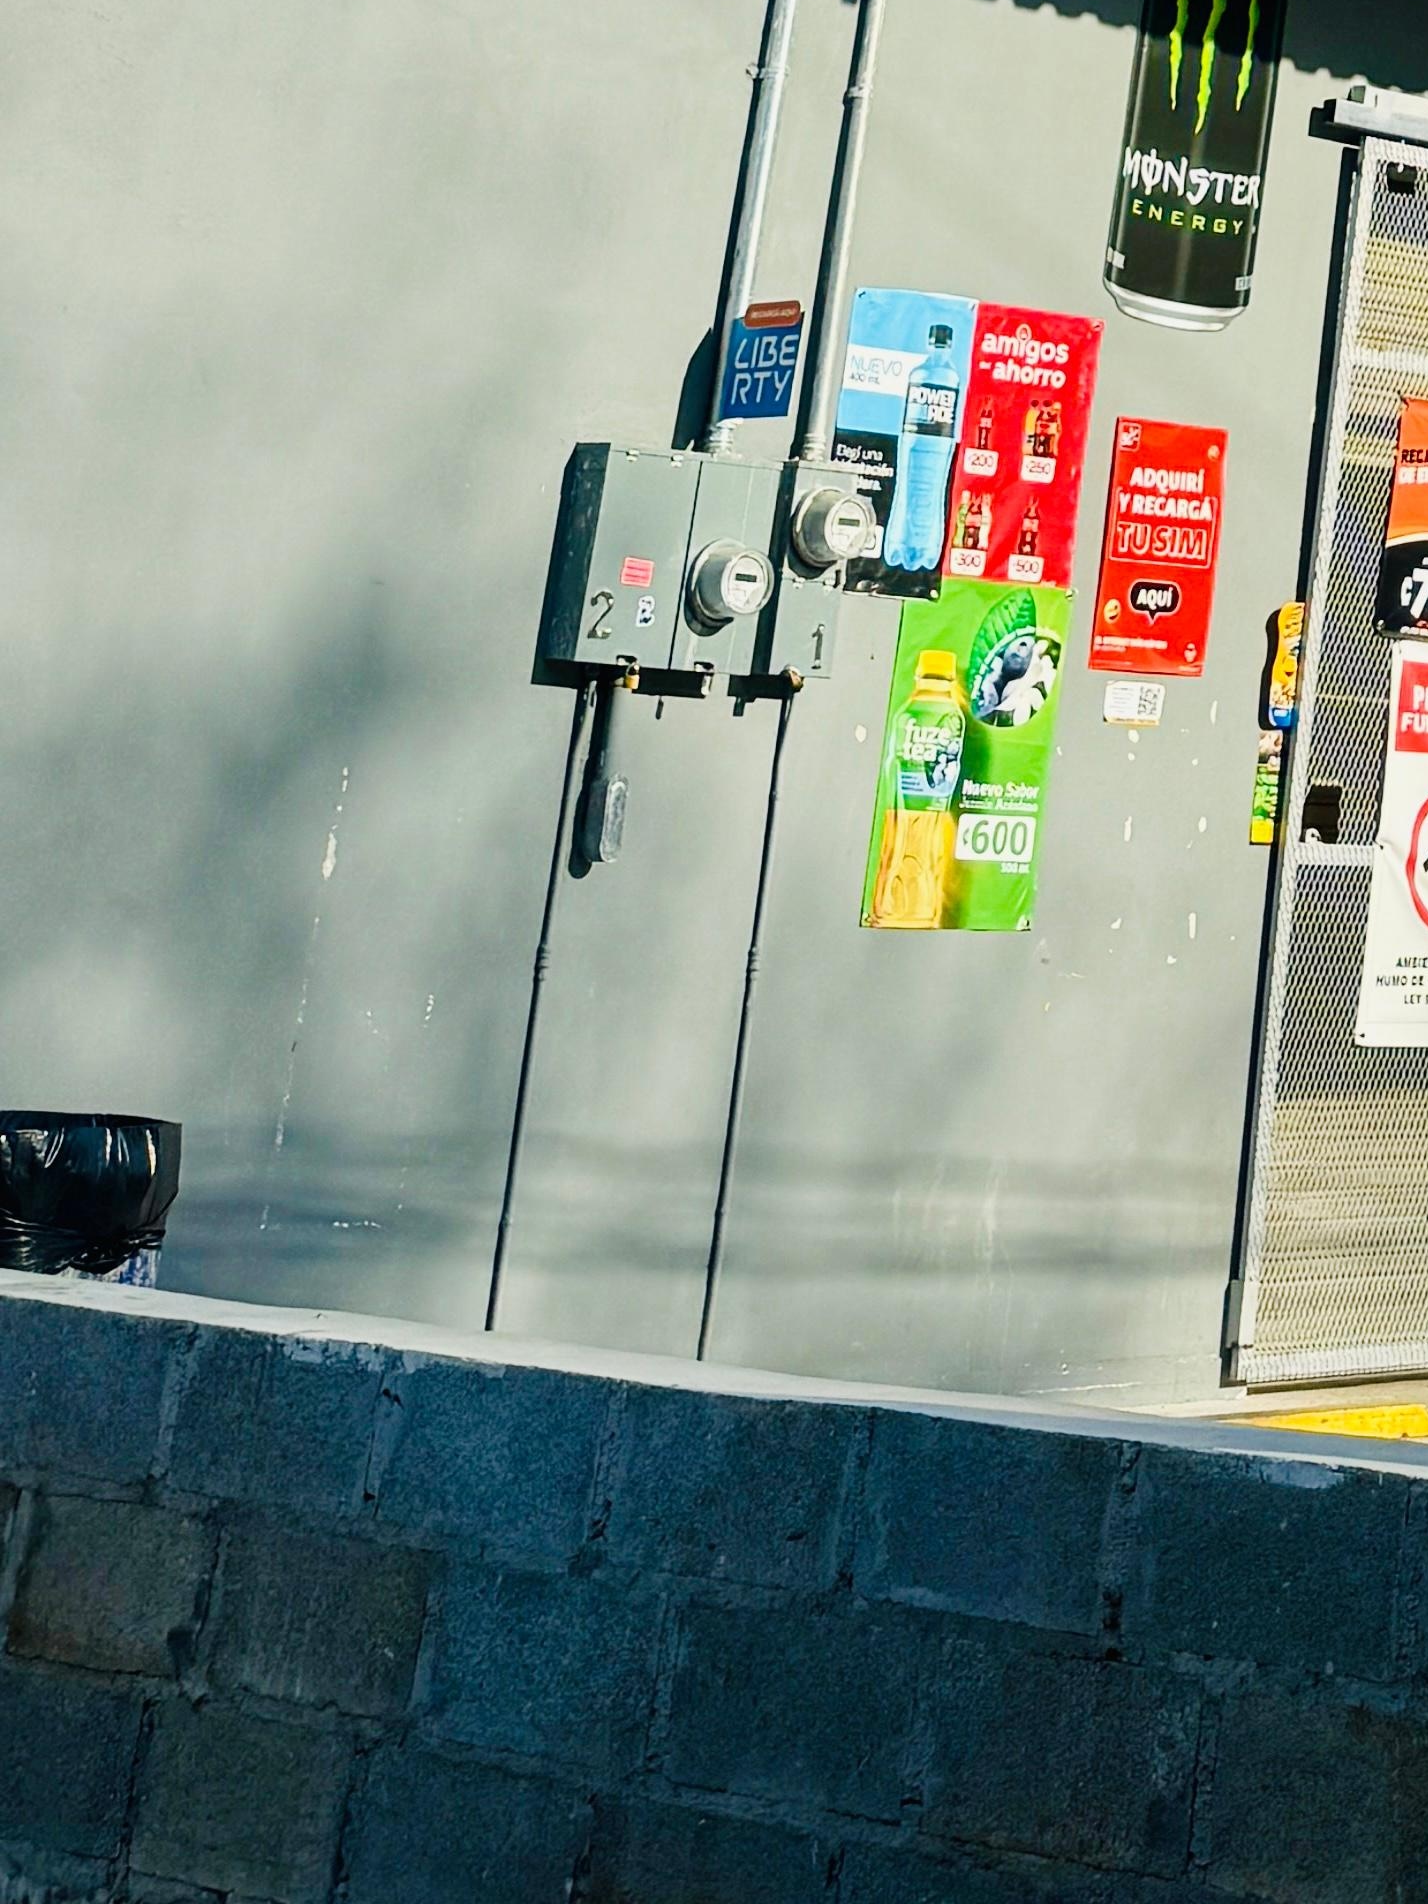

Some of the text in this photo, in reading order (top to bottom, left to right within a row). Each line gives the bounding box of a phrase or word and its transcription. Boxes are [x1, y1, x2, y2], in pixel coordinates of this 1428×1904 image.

[1123, 146, 1260, 210] MONSTER
[1132, 198, 1244, 235] ENERGY
[734, 334, 800, 369] LIBE
[981, 333, 1070, 365] amigos
[850, 354, 903, 377] NUEVO
[992, 358, 1067, 389] ahorro
[730, 369, 792, 405] RTY
[908, 386, 957, 409] POWER
[863, 447, 884, 461] una
[1130, 467, 1205, 494] ADQUIRÍ
[1118, 492, 1213, 521] Y RECARGÁ
[1117, 521, 1207, 560] TU SIM
[1136, 586, 1174, 611] AQUÍ
[587, 591, 615, 639] 2
[812, 623, 826, 669] 1
[903, 717, 951, 748] fuze
[902, 742, 938, 763] tea
[962, 778, 1003, 798] Nuevo
[1376, 974, 1409, 987] HUMO
[1411, 975, 1424, 987] DE
